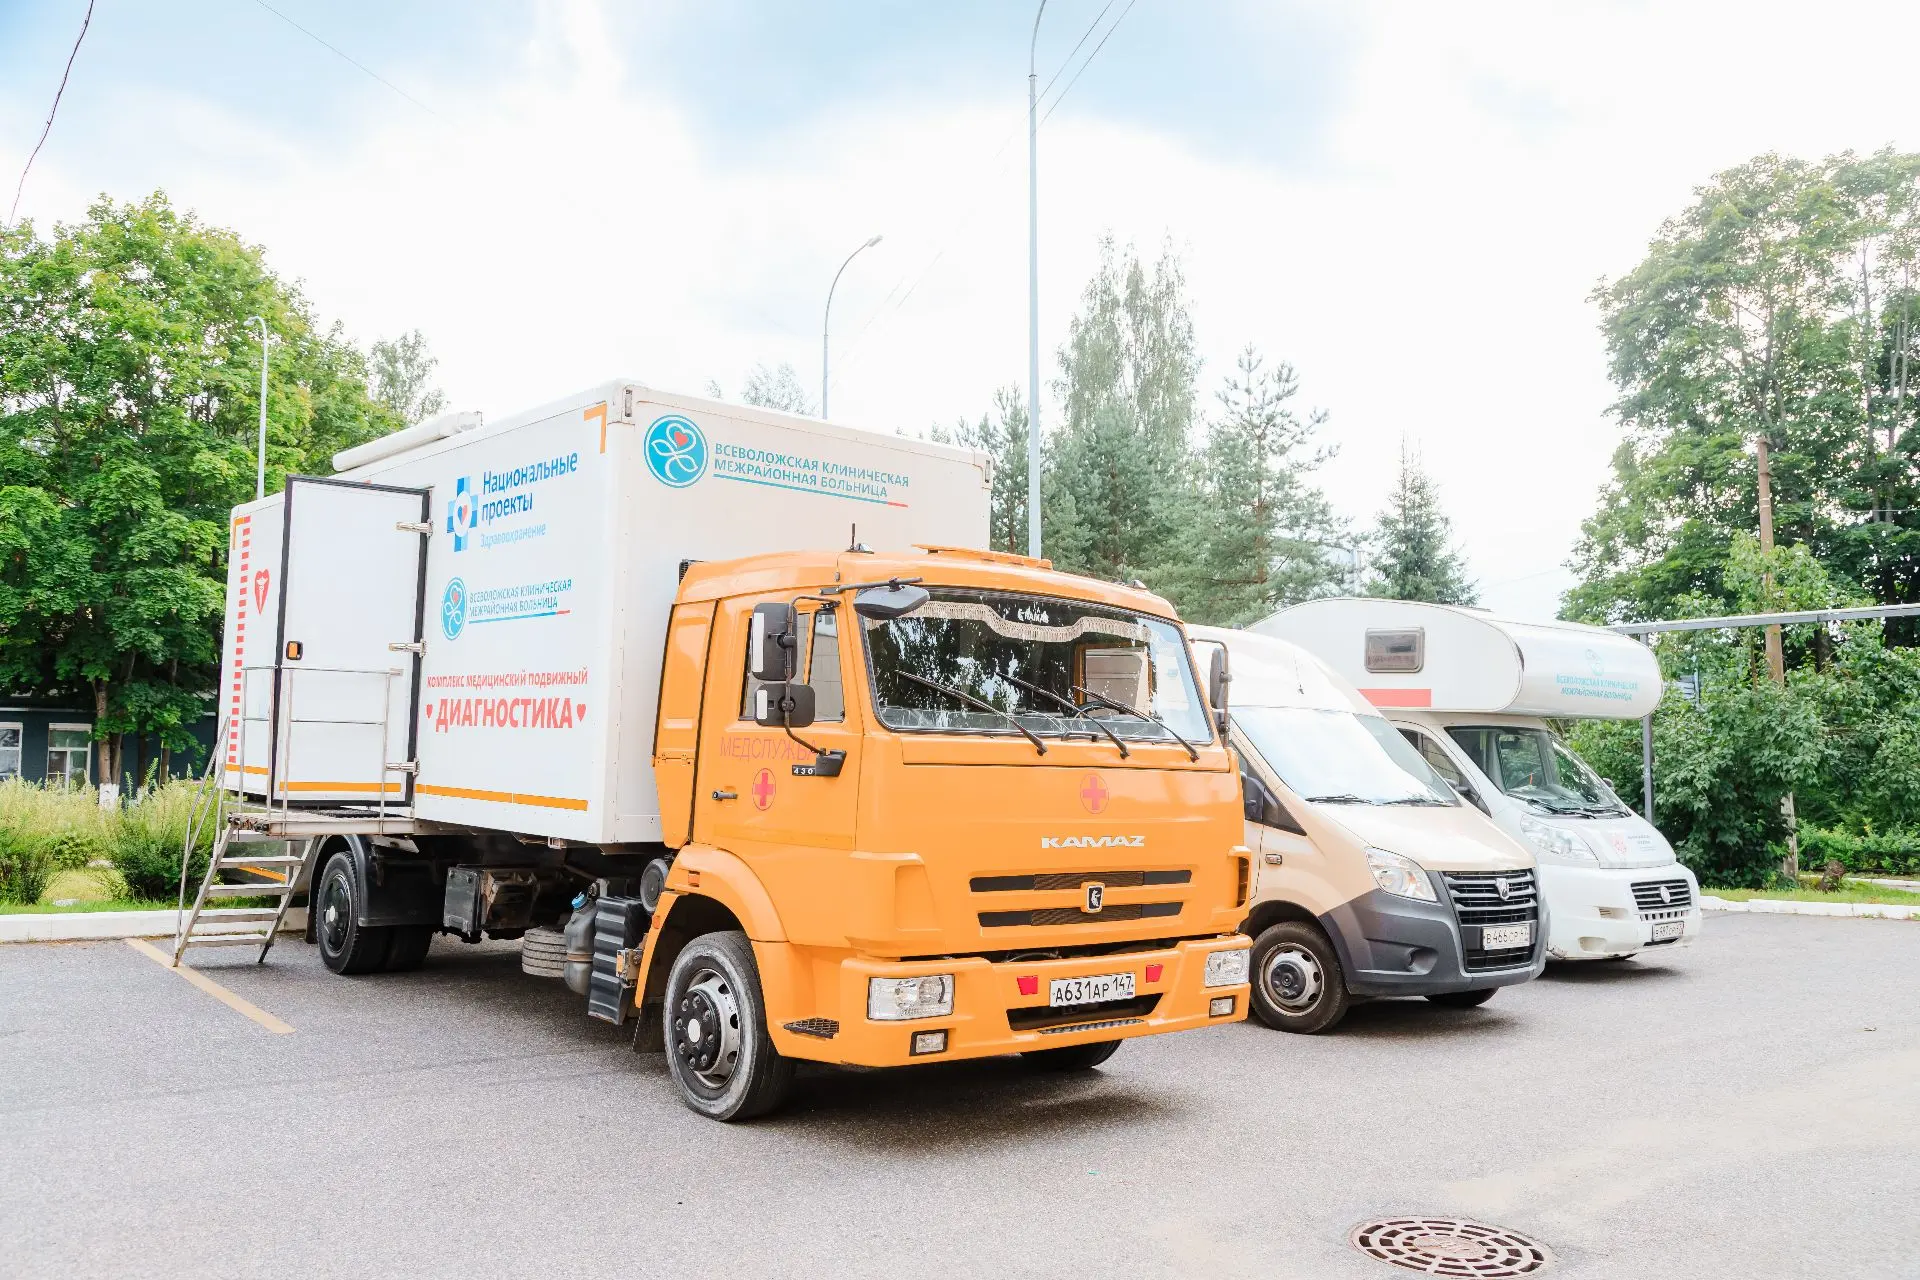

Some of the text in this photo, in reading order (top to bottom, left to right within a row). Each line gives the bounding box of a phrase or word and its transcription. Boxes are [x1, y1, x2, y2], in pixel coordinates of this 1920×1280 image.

[483, 452, 578, 495] Национальные
[714, 443, 910, 487] ВСЕВОЛОЖСКАЯ КЛИНИЧЕСКАЯ
[714, 458, 888, 499] МЕЖРАЙОННАЯ БОЛЬНИЦА
[481, 493, 533, 526] проекты
[480, 523, 547, 550] Здравоохранение
[469, 579, 572, 604] ВСЕВОЛОЖСКАЯ КЛИНИЧЕСКАЯ
[469, 596, 558, 618] МЕЖРАЙОННАЯ БОЛЬНИЦА
[427, 666, 588, 689] КОМПЛЕКС МЕДИЦИНСКИЙ ПОДВИЖНЫЙ
[435, 697, 573, 733] ДИАГНОСТИКА
[1041, 835, 1146, 849] KAMAZ
